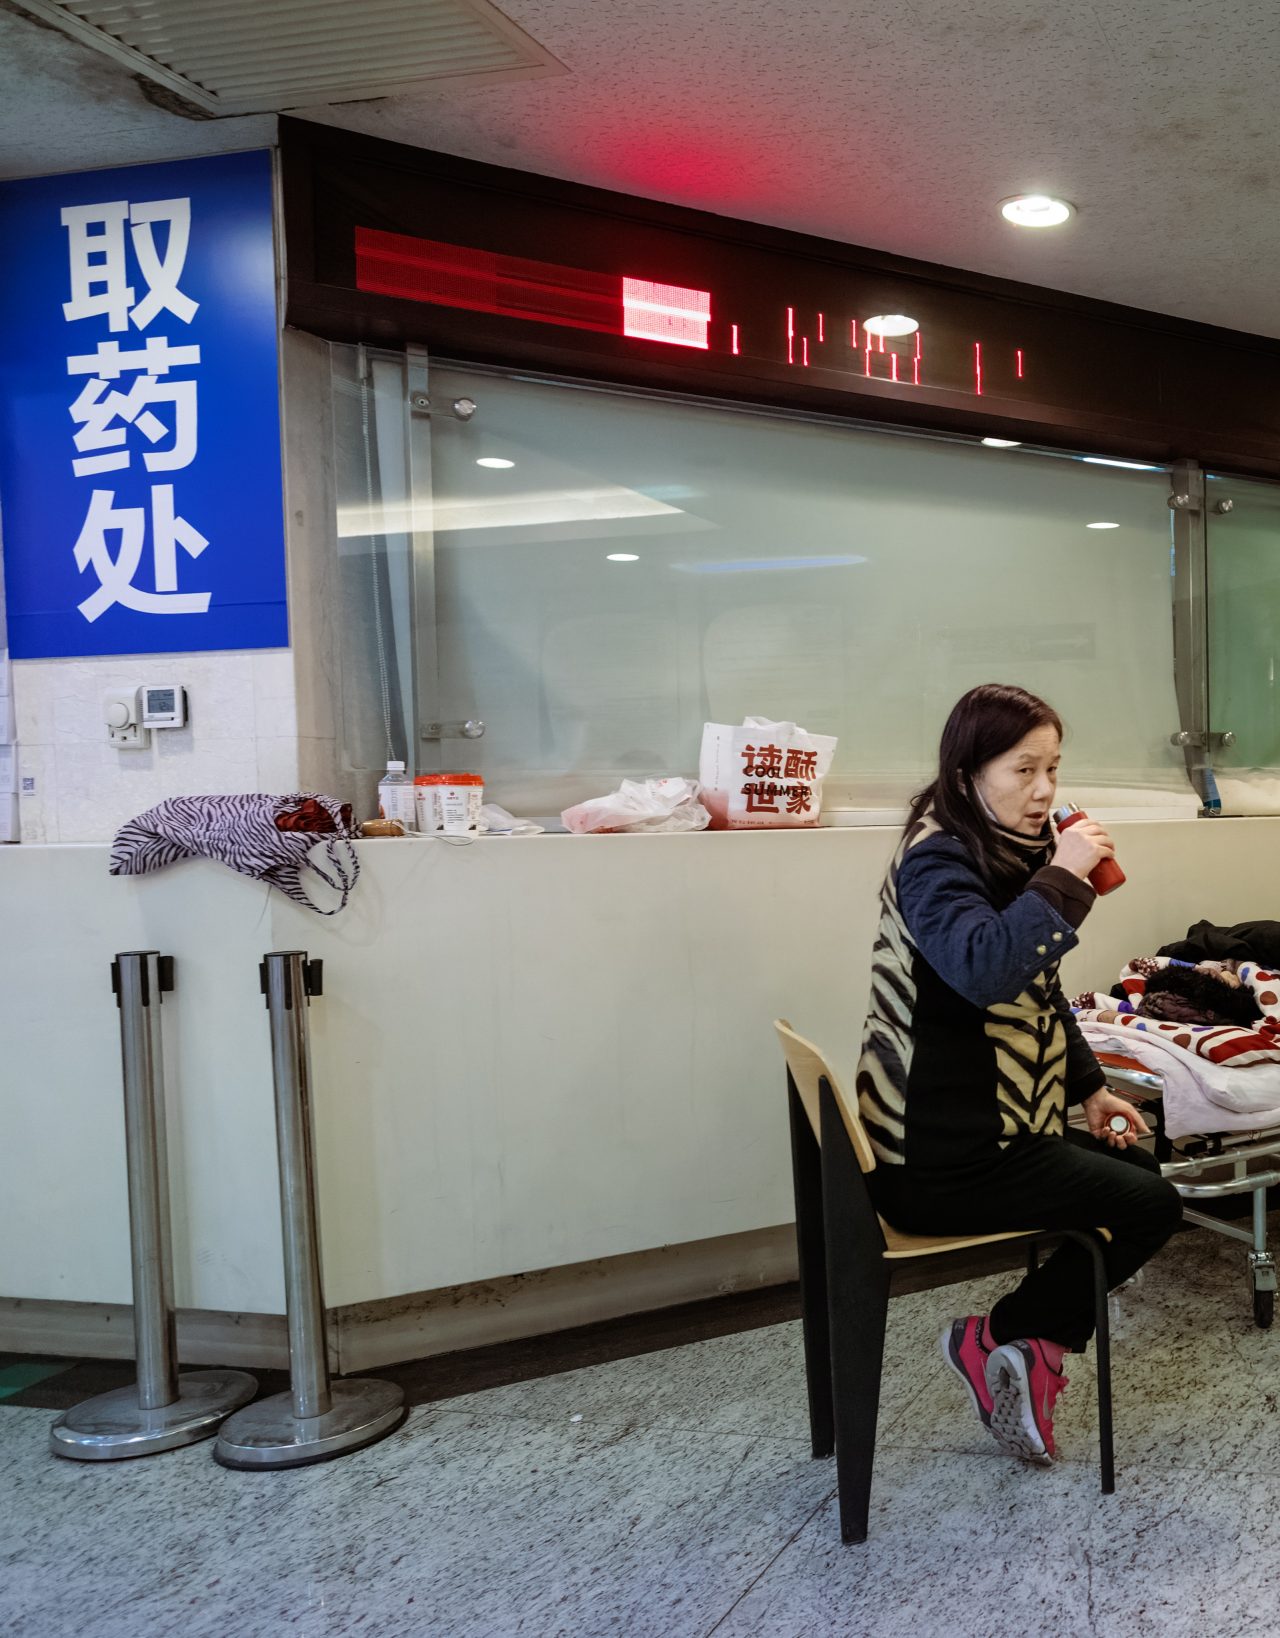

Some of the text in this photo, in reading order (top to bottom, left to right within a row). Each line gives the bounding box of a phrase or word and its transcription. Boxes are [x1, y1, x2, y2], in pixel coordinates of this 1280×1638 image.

[61, 197, 212, 623] 取药处
[741, 744, 818, 781] 读酥
[743, 765, 784, 780] COOL
[741, 781, 813, 814] 世家
[743, 783, 813, 797] SUMMER
